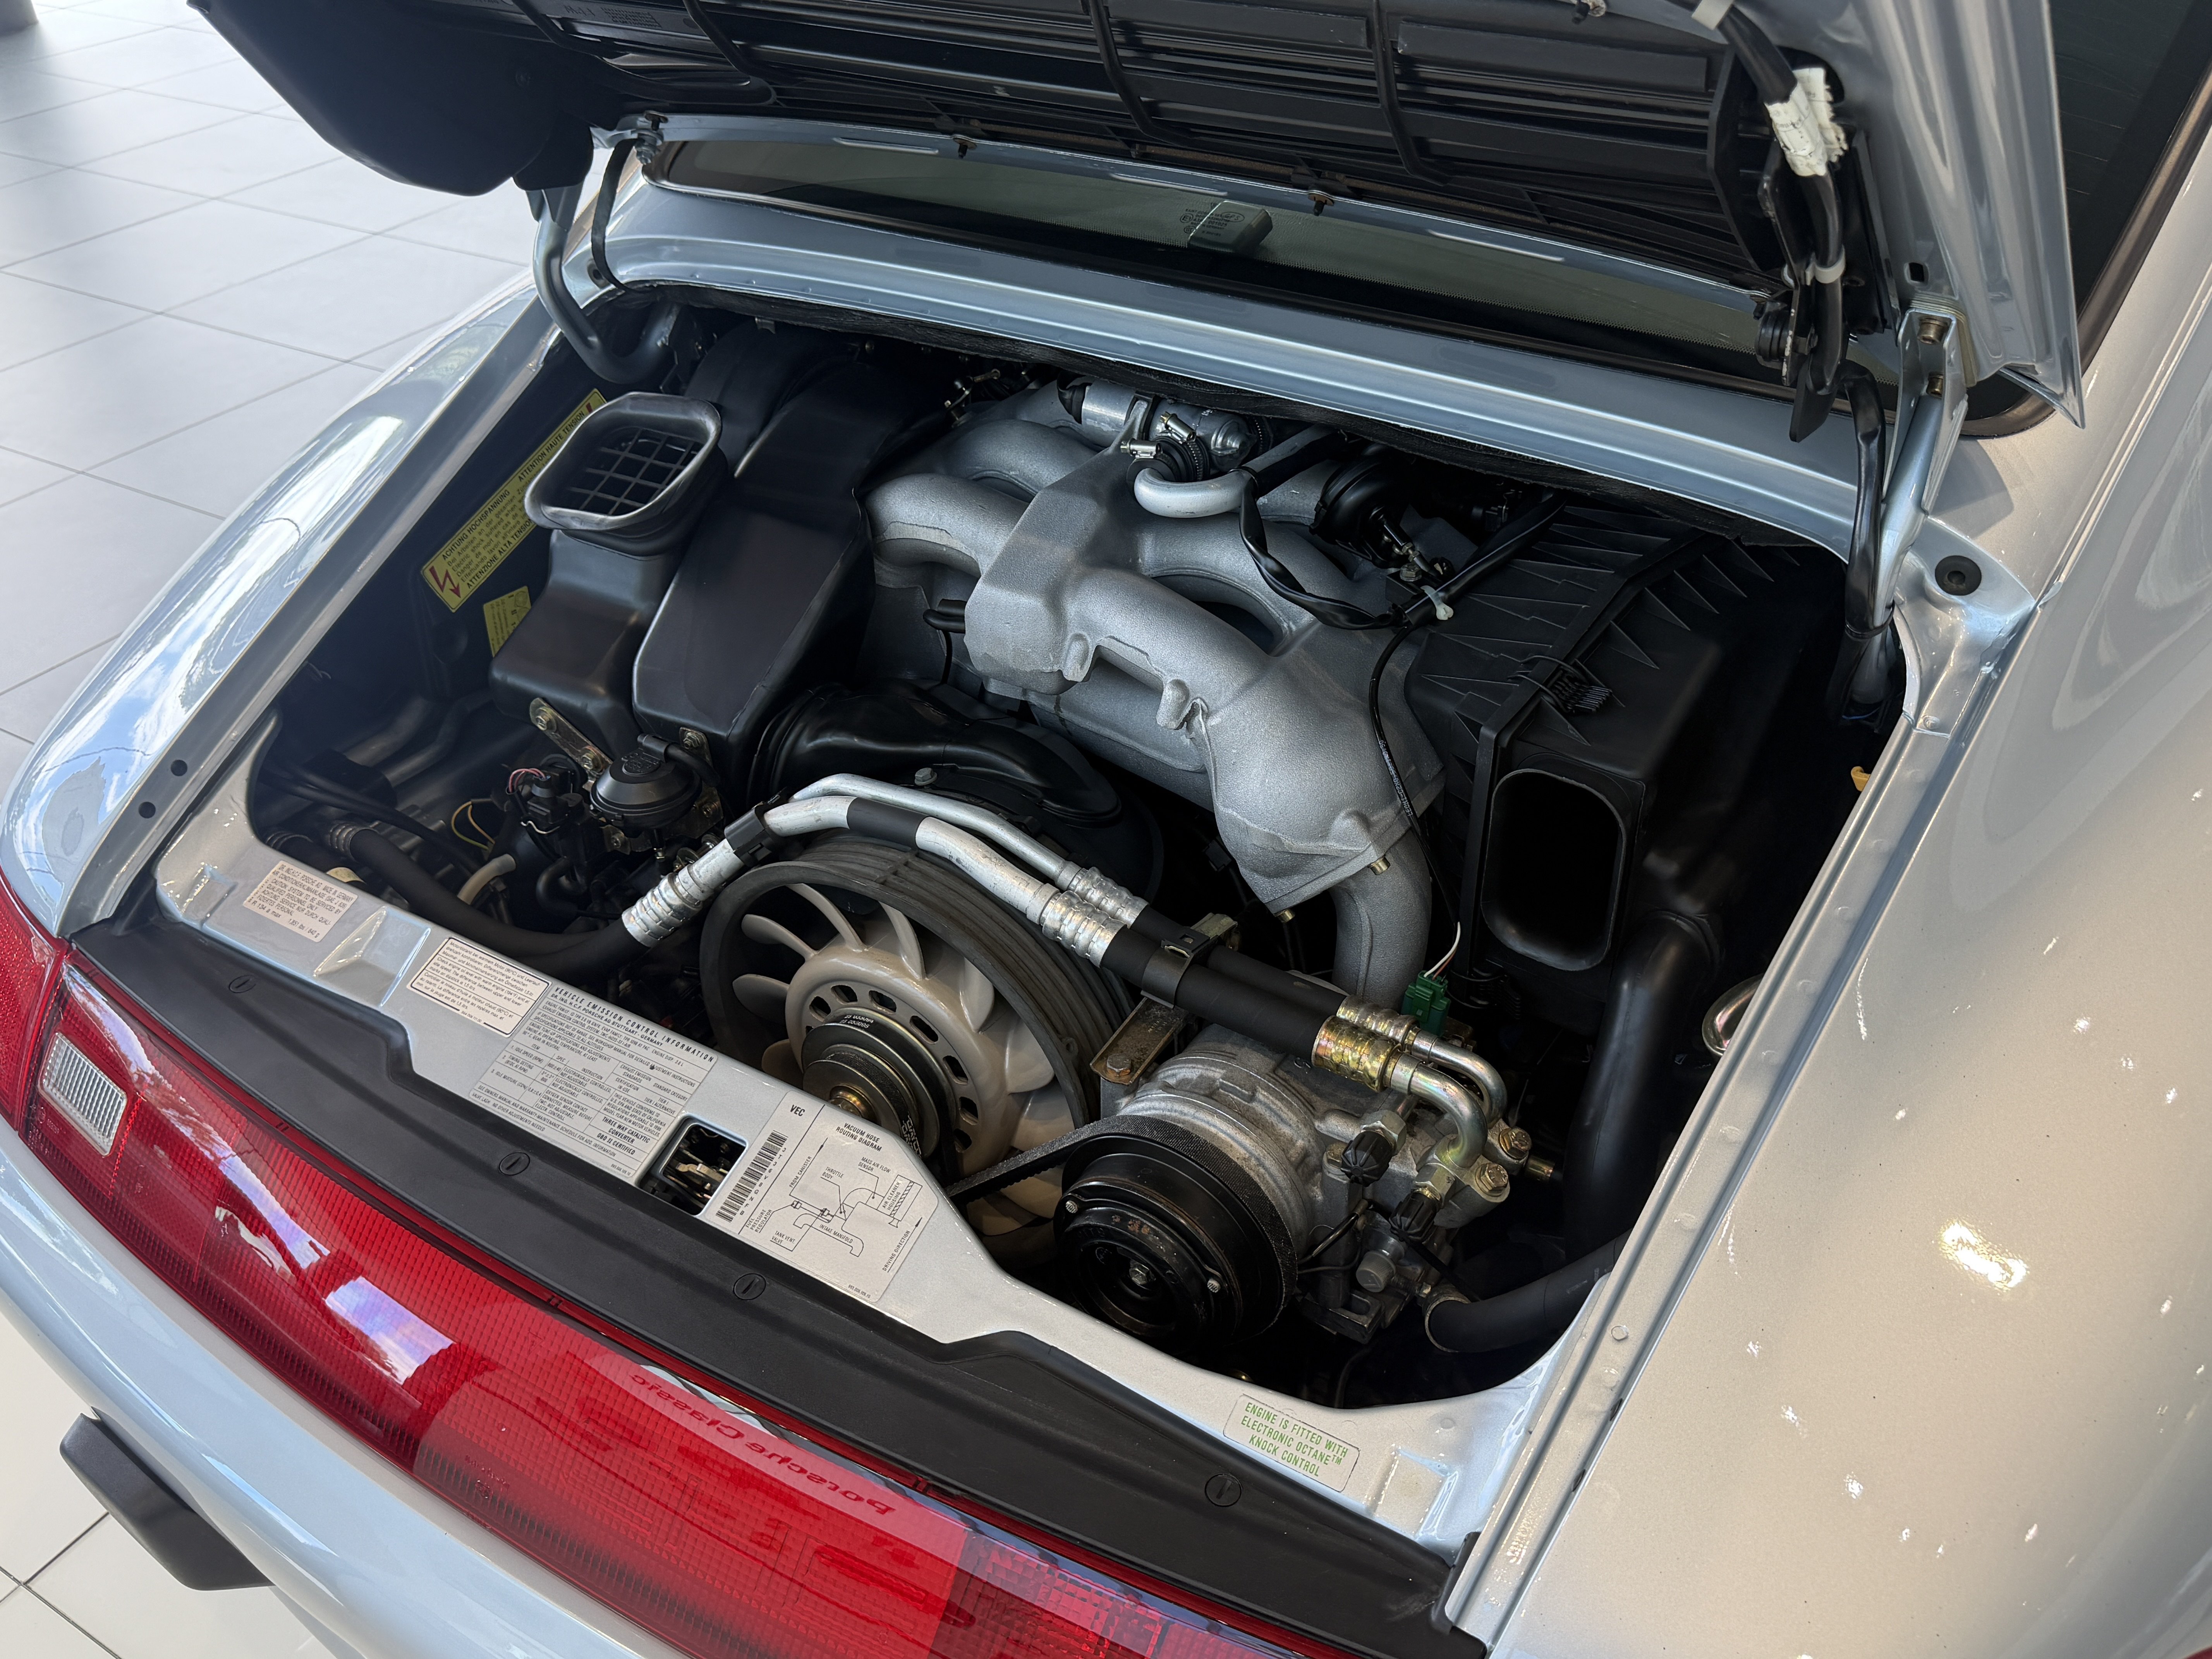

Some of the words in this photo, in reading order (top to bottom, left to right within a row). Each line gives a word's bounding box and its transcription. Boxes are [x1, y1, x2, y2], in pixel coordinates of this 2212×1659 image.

[518, 451, 546, 482] ATTENTION
[545, 433, 563, 453] HAUTE
[562, 410, 584, 434] TENSION
[442, 532, 468, 560] ACHTUNG
[467, 489, 510, 534] HOCHSPANNUNG
[452, 553, 470, 572] Electric
[471, 538, 484, 553] shock
[505, 504, 517, 517] when
[457, 536, 476, 556] Arbeiten
[485, 518, 493, 528] der
[482, 538, 494, 550] mort
[467, 554, 498, 589] ATTENZIONE
[498, 540, 512, 556] ALTA
[511, 518, 533, 540] TENSION
[287, 886, 304, 896] SYSTEM
[542, 1005, 557, 1013] EXHAUST
[555, 1011, 572, 1021] EMISSION
[571, 1018, 586, 1027] CONTROL
[555, 987, 585, 1003] VEHICLE
[587, 1001, 623, 1021] EMISSION
[626, 1019, 658, 1037] CONTROL
[661, 1035, 714, 1062] INFORMATION
[533, 1016, 558, 1029] SPECIFICATIONS
[557, 1027, 576, 1038] APPLICABLE
[582, 1007, 604, 1020] PORSCHE
[611, 1021, 637, 1035] STUTTGART
[640, 1034, 663, 1046] GERMANY
[563, 1067, 590, 1082] ELECTRONICALLY
[581, 1067, 603, 1080] INSTRUCTION
[620, 1064, 635, 1073] EXHAUST
[634, 1070, 651, 1081] EMISSION
[622, 1071, 642, 1083] STANDARDS
[615, 1077, 639, 1091] CERTIFICATION
[653, 1082, 671, 1094] STANDARD
[670, 1091, 687, 1101] CATEGORY
[654, 1102, 675, 1115] ALTERNATIVE
[790, 1104, 805, 1116] VEC
[602, 1116, 617, 1127] THREE
[617, 1123, 628, 1132] WAY
[627, 1129, 650, 1143] CATALYTIC
[646, 1115, 666, 1127] CALIFORNIA
[608, 1128, 635, 1144] CONVERTER
[835, 1126, 858, 1140] ROUTING
[858, 1137, 882, 1151] DIAGRAM
[844, 1122, 866, 1136] VACUUM
[866, 1133, 880, 1143] HOSE
[596, 1132, 607, 1141] OBD
[612, 1140, 635, 1155] CERTIFIED
[789, 1177, 798, 1188] FROM
[795, 1156, 812, 1178] CANISTER
[825, 1166, 844, 1178] THROTTLE
[858, 1161, 874, 1172] SENSOR
[861, 1156, 872, 1164] MASS
[879, 1165, 891, 1173] FLOW
[822, 1171, 833, 1179] BODY
[886, 1182, 900, 1200] CLEANER
[886, 1191, 901, 1211] HOUSING
[750, 1209, 766, 1230] PRESSURE
[754, 1209, 772, 1233] REGULATOR
[771, 1235, 783, 1244] VALVE
[775, 1230, 785, 1238] TANK
[819, 1224, 833, 1233] INTAKE
[833, 1230, 853, 1243] MANIFOLD
[882, 1255, 894, 1271] DRIVING
[893, 1230, 910, 1255] DIRECTION
[1241, 1415, 1293, 1447] ELECTRONIC
[1245, 1402, 1278, 1424] ENGINE
[1279, 1418, 1289, 1429] IS
[1291, 1424, 1322, 1445] FITTED
[1324, 1439, 1348, 1458] WITH
[1249, 1434, 1279, 1456] KNOCK
[1281, 1450, 1319, 1477] CONTROL
